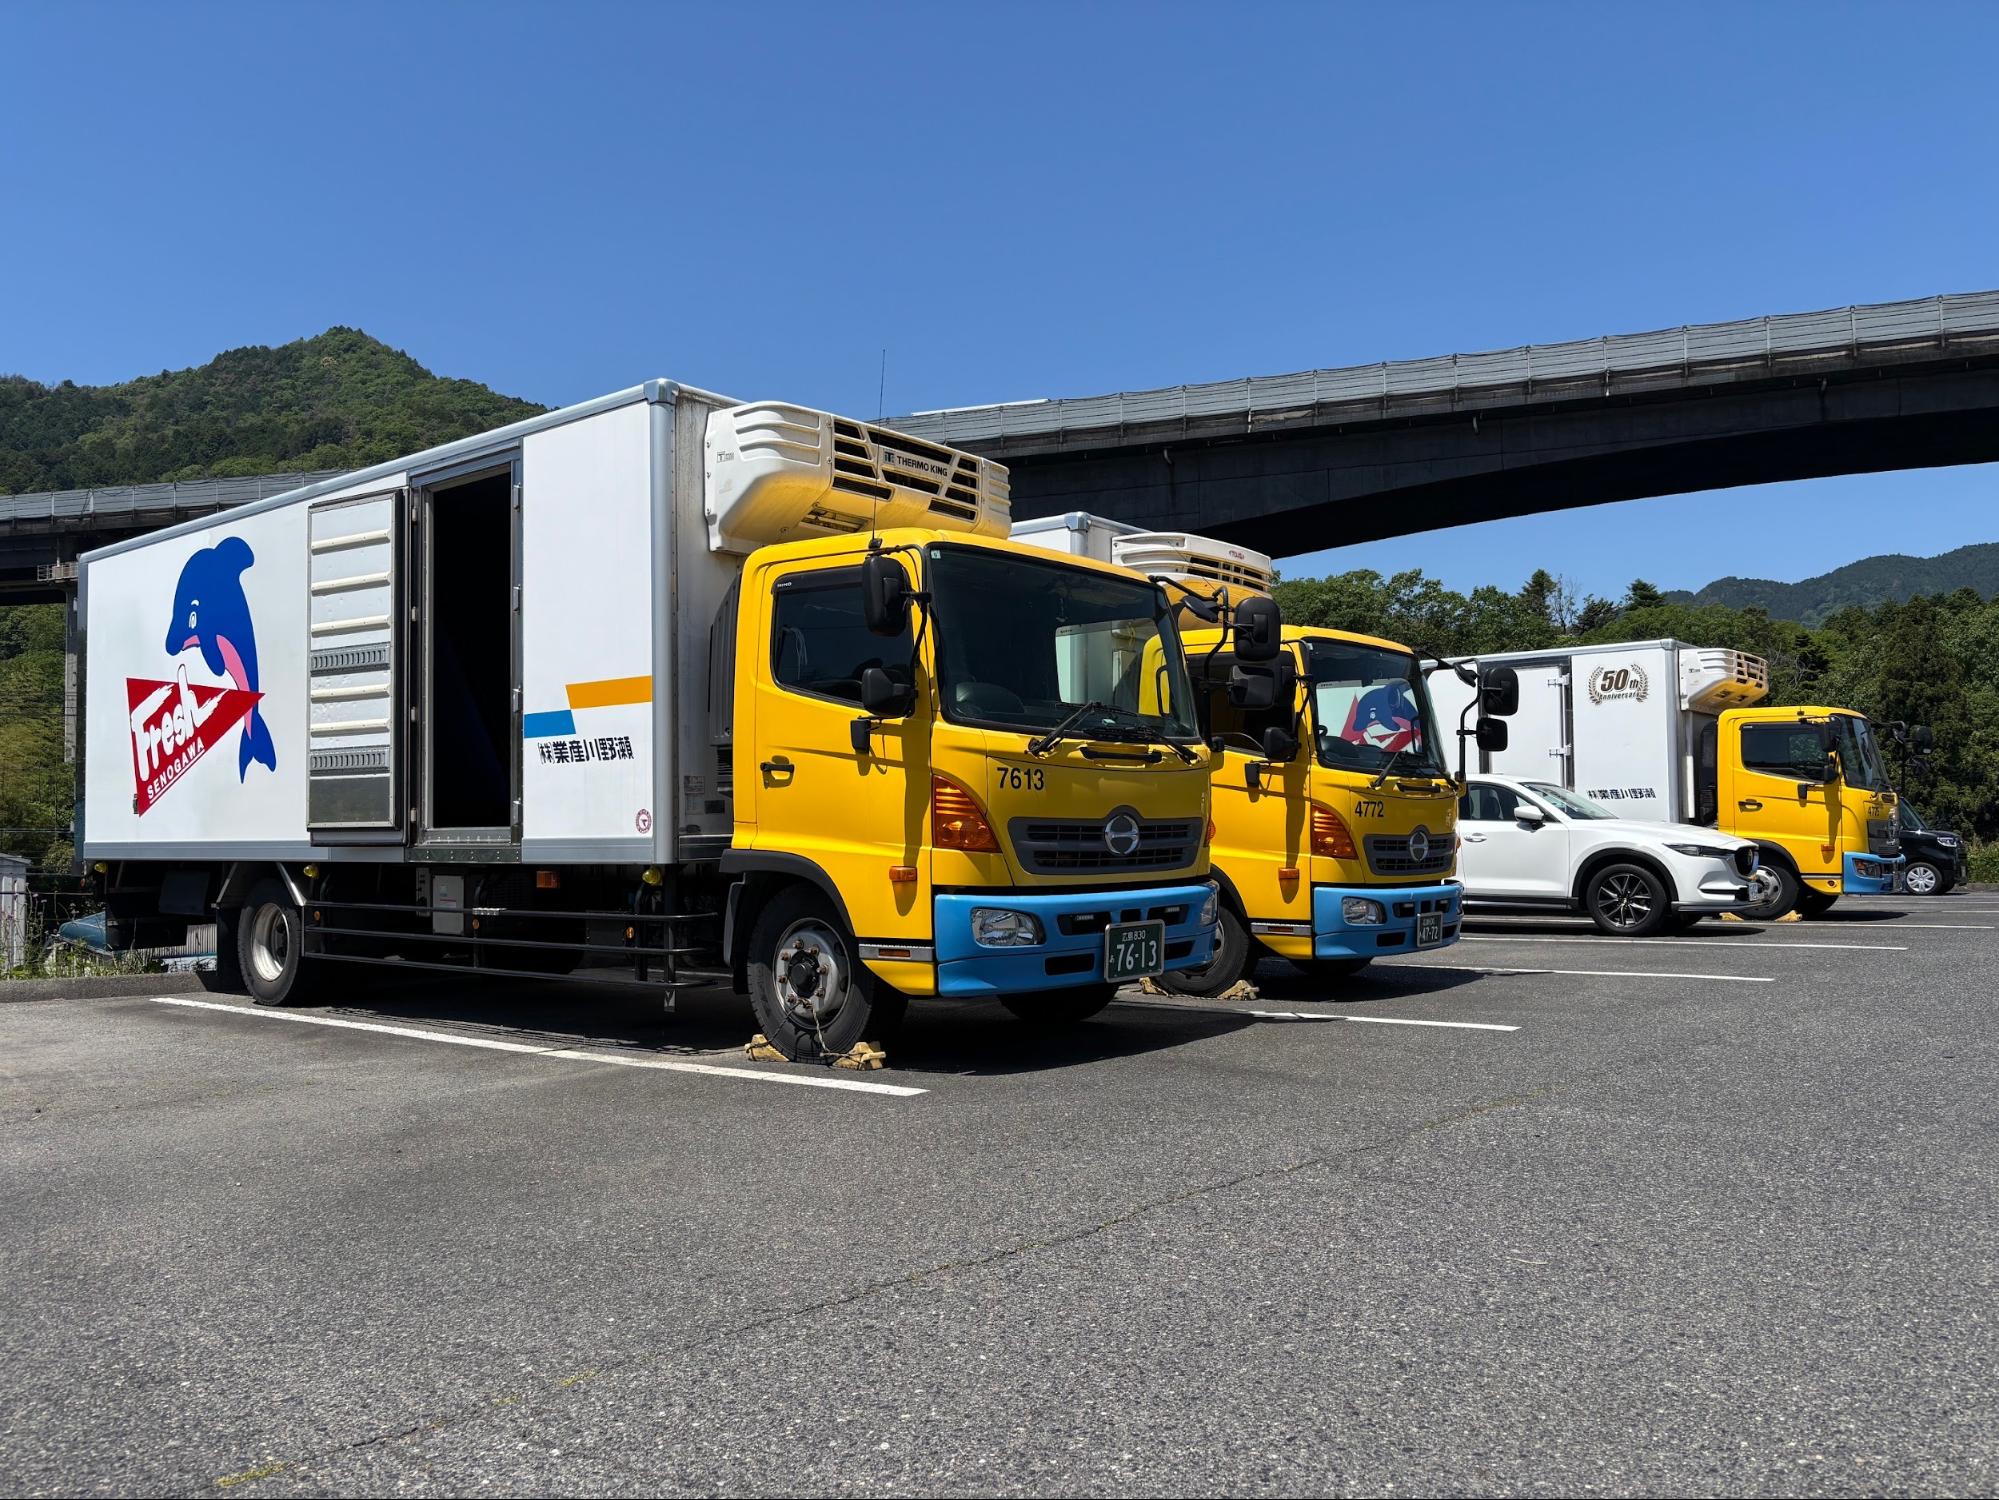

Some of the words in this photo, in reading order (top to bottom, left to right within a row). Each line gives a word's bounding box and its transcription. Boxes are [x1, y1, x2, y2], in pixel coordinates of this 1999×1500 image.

[897, 455, 929, 471] THERMO
[930, 464, 948, 476] KING
[130, 663, 229, 782] Fresh
[146, 736, 205, 799] SENOGAWA
[996, 767, 1044, 791] 7613
[1354, 800, 1384, 818] 4772
